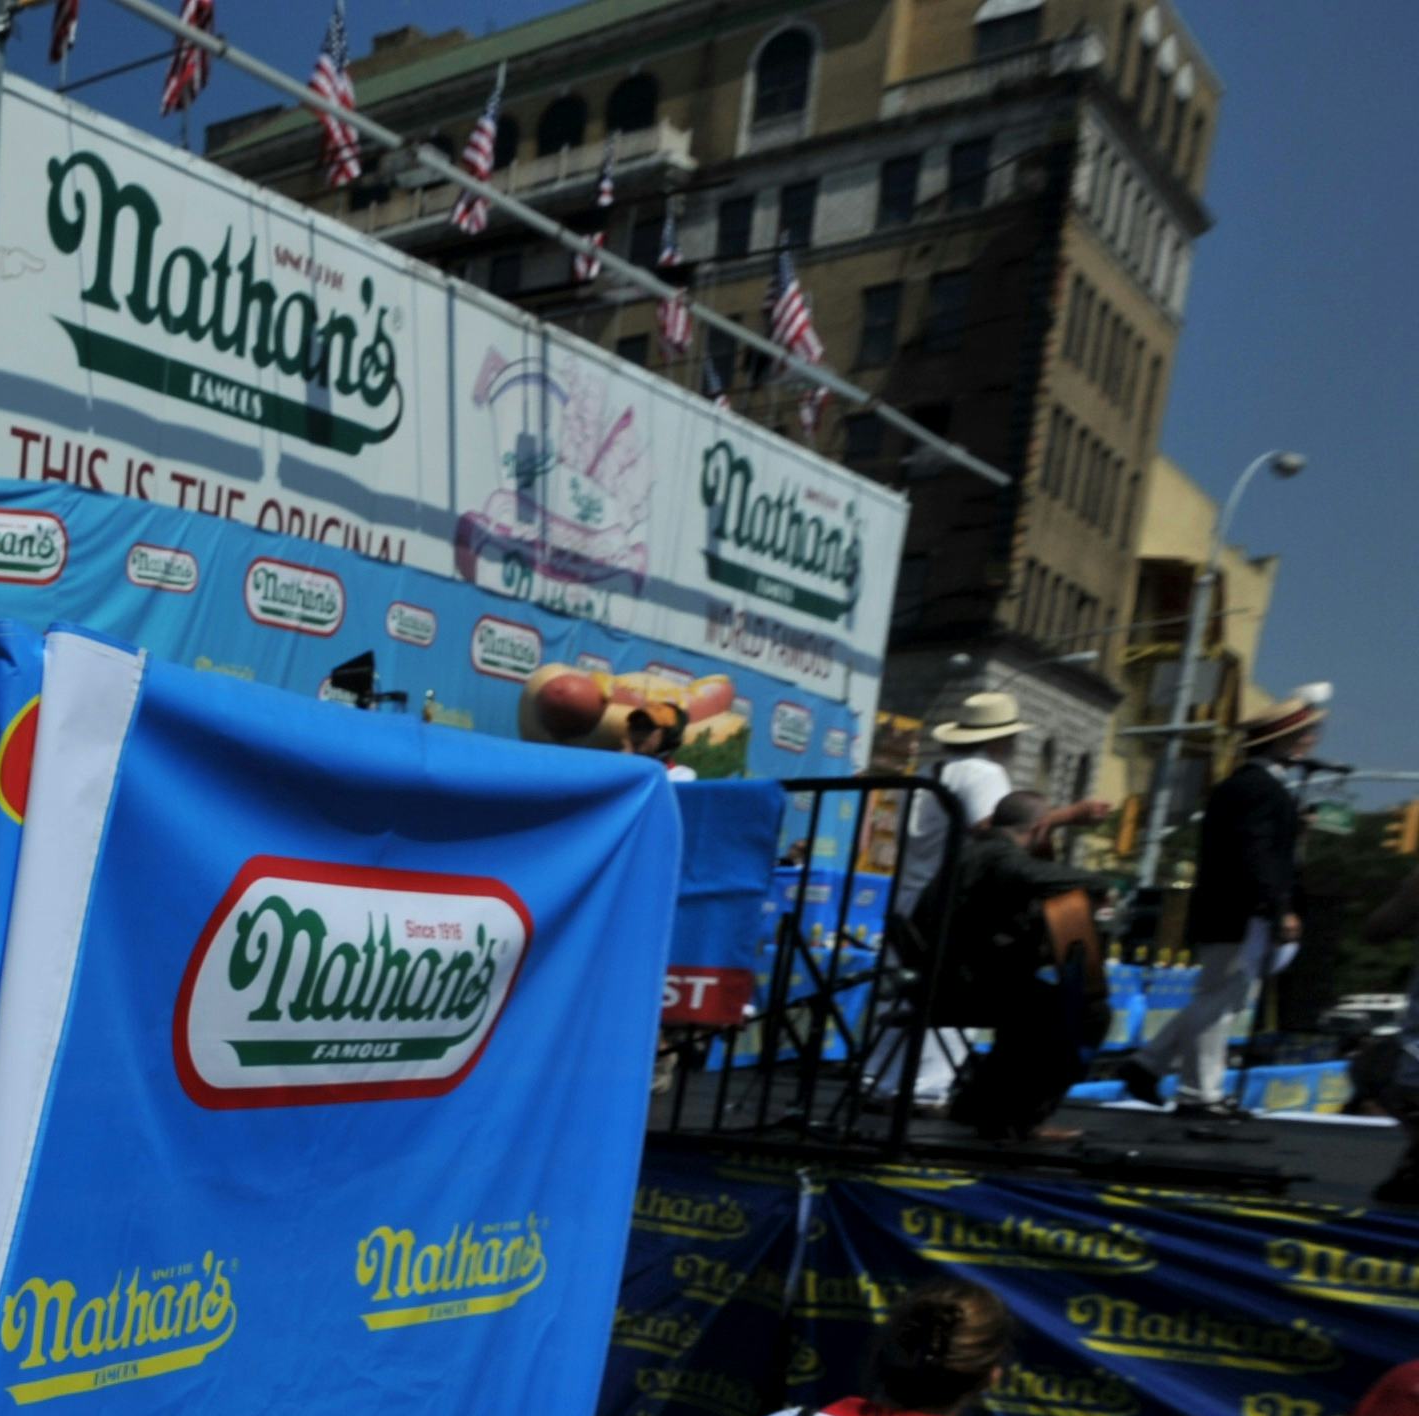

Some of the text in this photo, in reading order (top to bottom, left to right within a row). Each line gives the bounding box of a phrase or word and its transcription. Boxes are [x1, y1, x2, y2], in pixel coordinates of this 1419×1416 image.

[47, 151, 399, 407] Nathan's
[189, 371, 264, 420] FAMOUS
[10, 427, 108, 491] THIS
[701, 440, 862, 588] Nathan's
[229, 894, 496, 1023] Nathan's
[405, 919, 436, 939] Since
[312, 1042, 403, 1060] FAMOUS
[355, 1211, 547, 1301] Nathan's
[901, 1205, 1157, 1264] Nathan's
[1, 1250, 237, 1370] Nathan's
